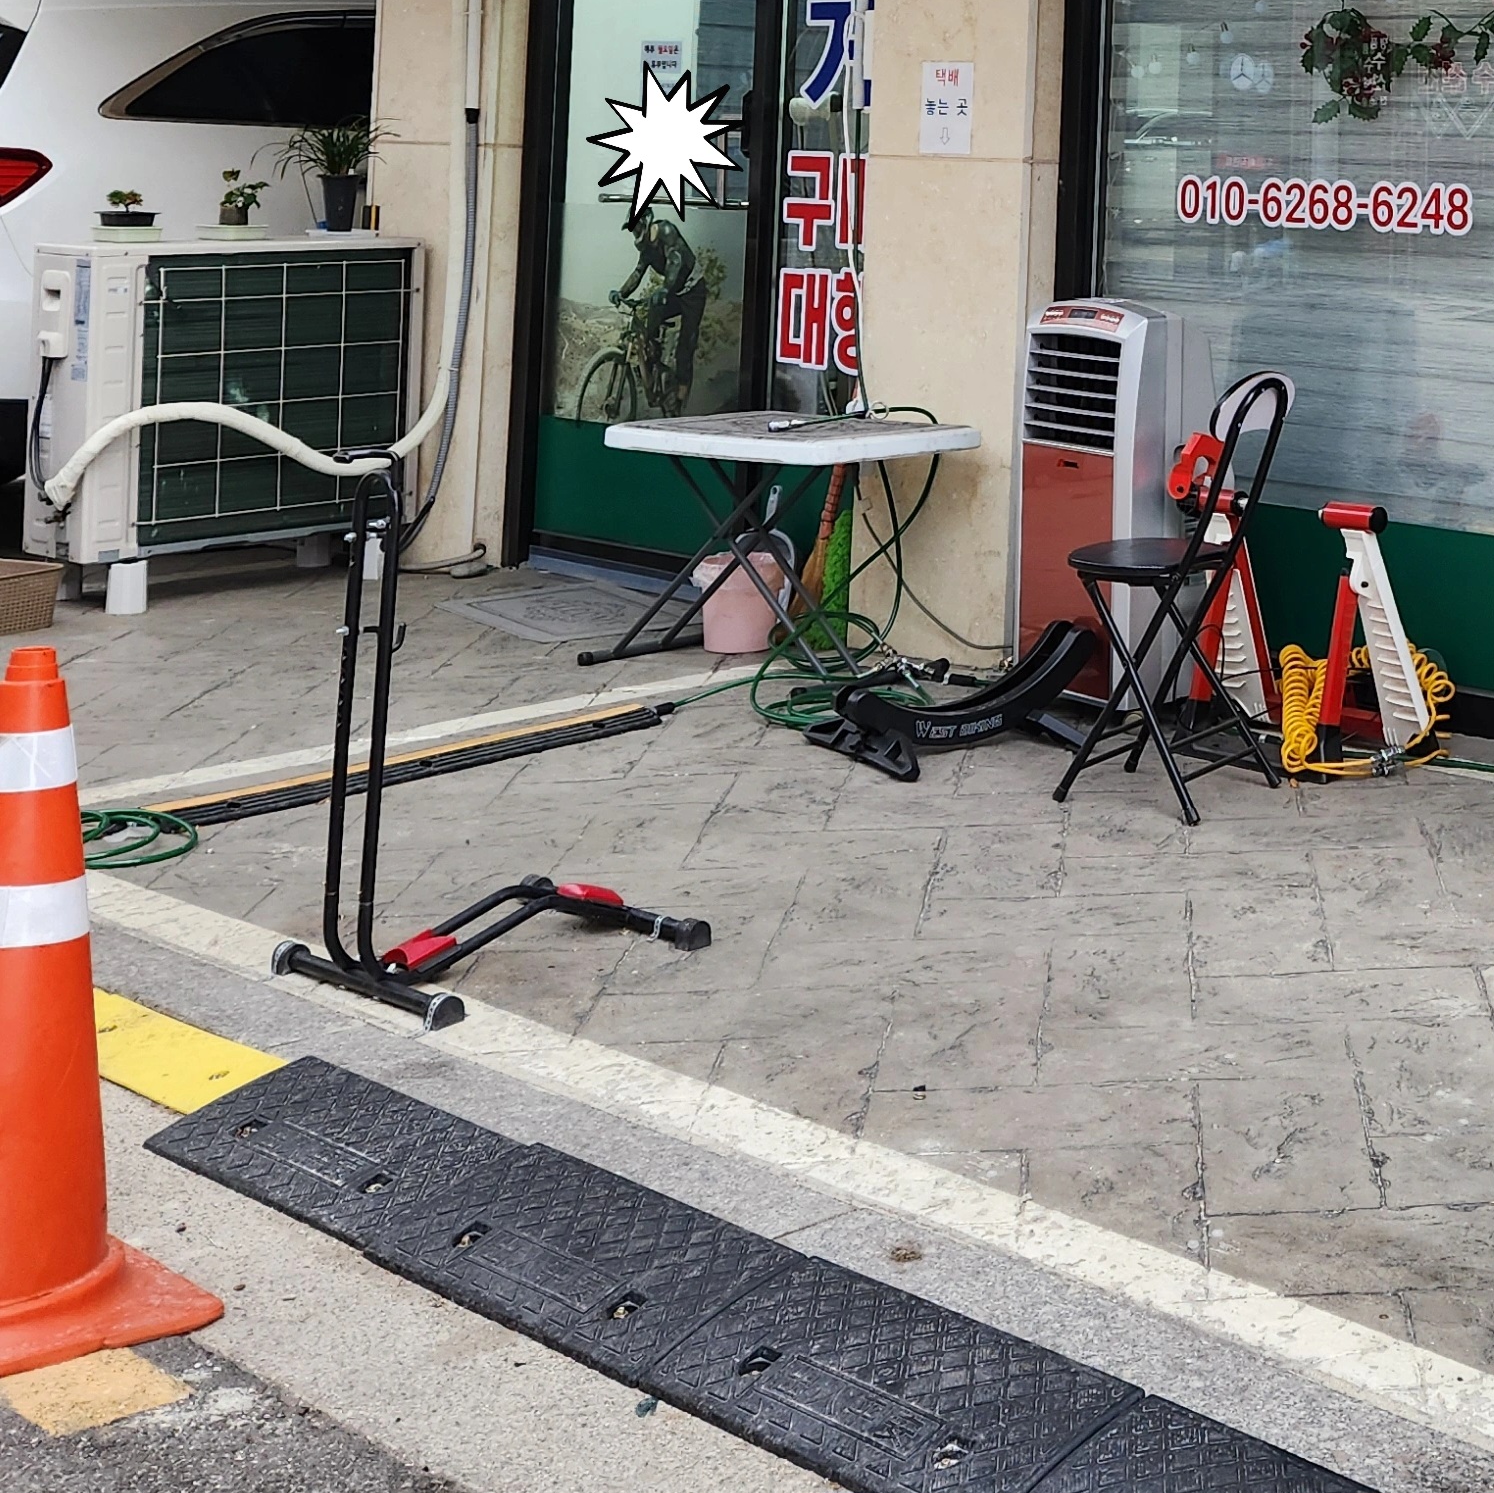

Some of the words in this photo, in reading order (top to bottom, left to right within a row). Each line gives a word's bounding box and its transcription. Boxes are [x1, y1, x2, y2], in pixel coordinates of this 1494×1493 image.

[935, 68, 959, 87] 택배
[925, 97, 949, 116] 놓는
[956, 98, 969, 116] 곳
[1180, 179, 1469, 231] 010-6268-6248
